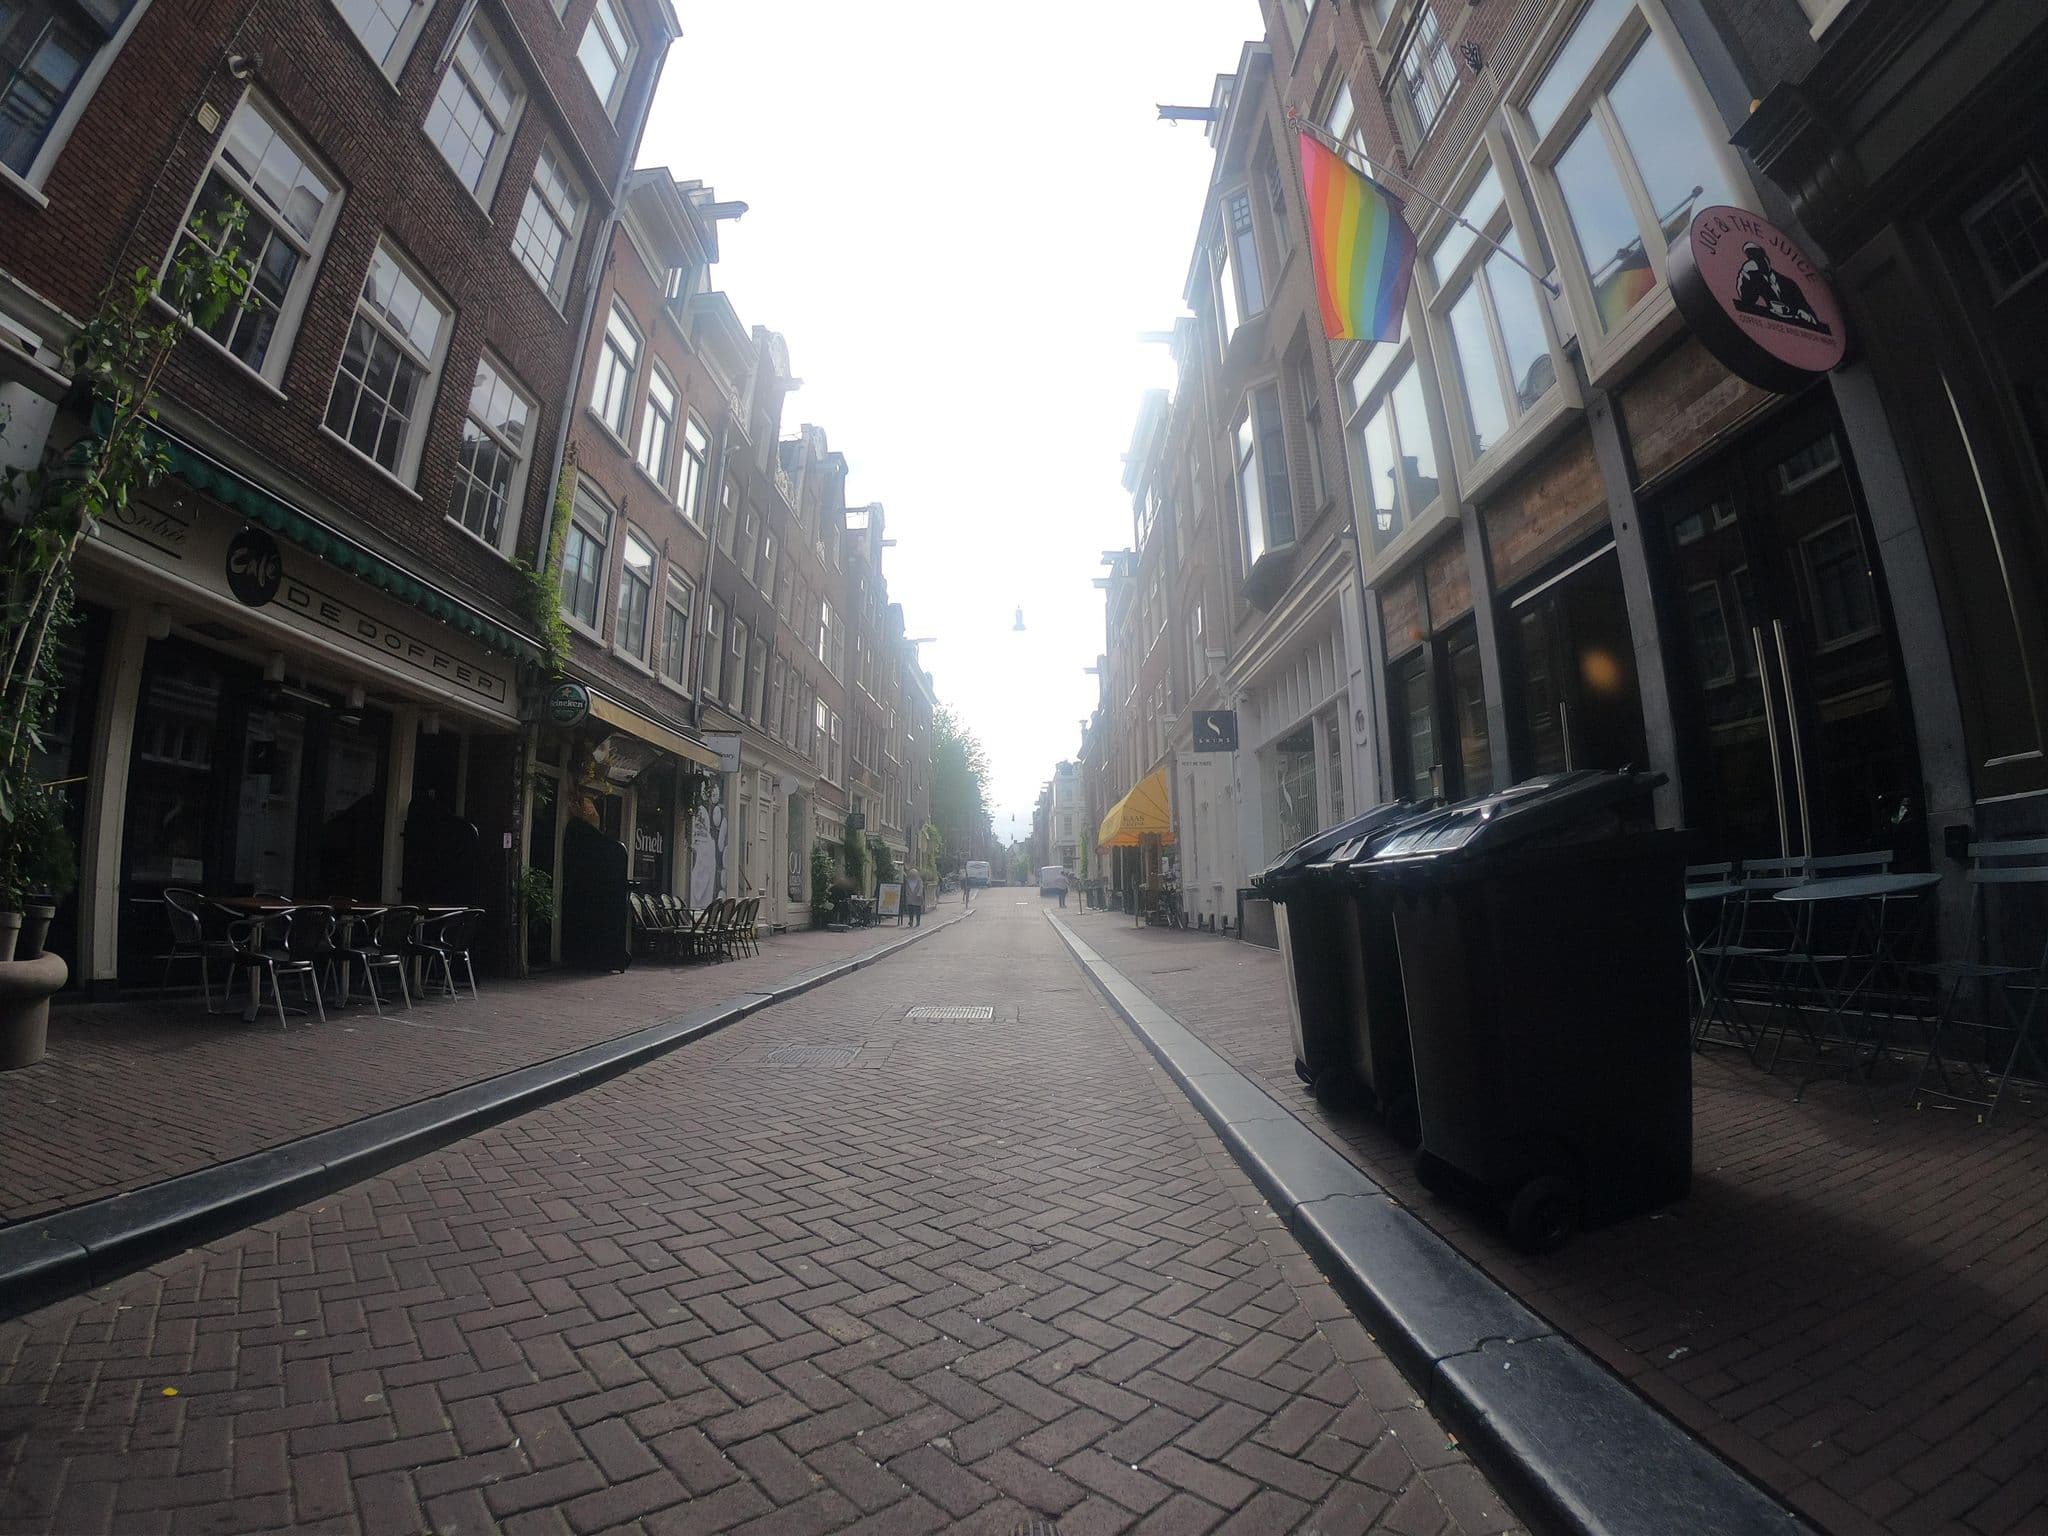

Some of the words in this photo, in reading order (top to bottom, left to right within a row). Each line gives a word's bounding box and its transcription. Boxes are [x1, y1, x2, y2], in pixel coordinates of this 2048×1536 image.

[1699, 222, 1722, 255] JOE
[1714, 216, 1730, 233] &
[1727, 215, 1764, 239] THE
[1768, 236, 1816, 282] JUICE
[287, 586, 342, 624] DE
[357, 619, 494, 690] DOFFER
[635, 827, 664, 854] Smelt
